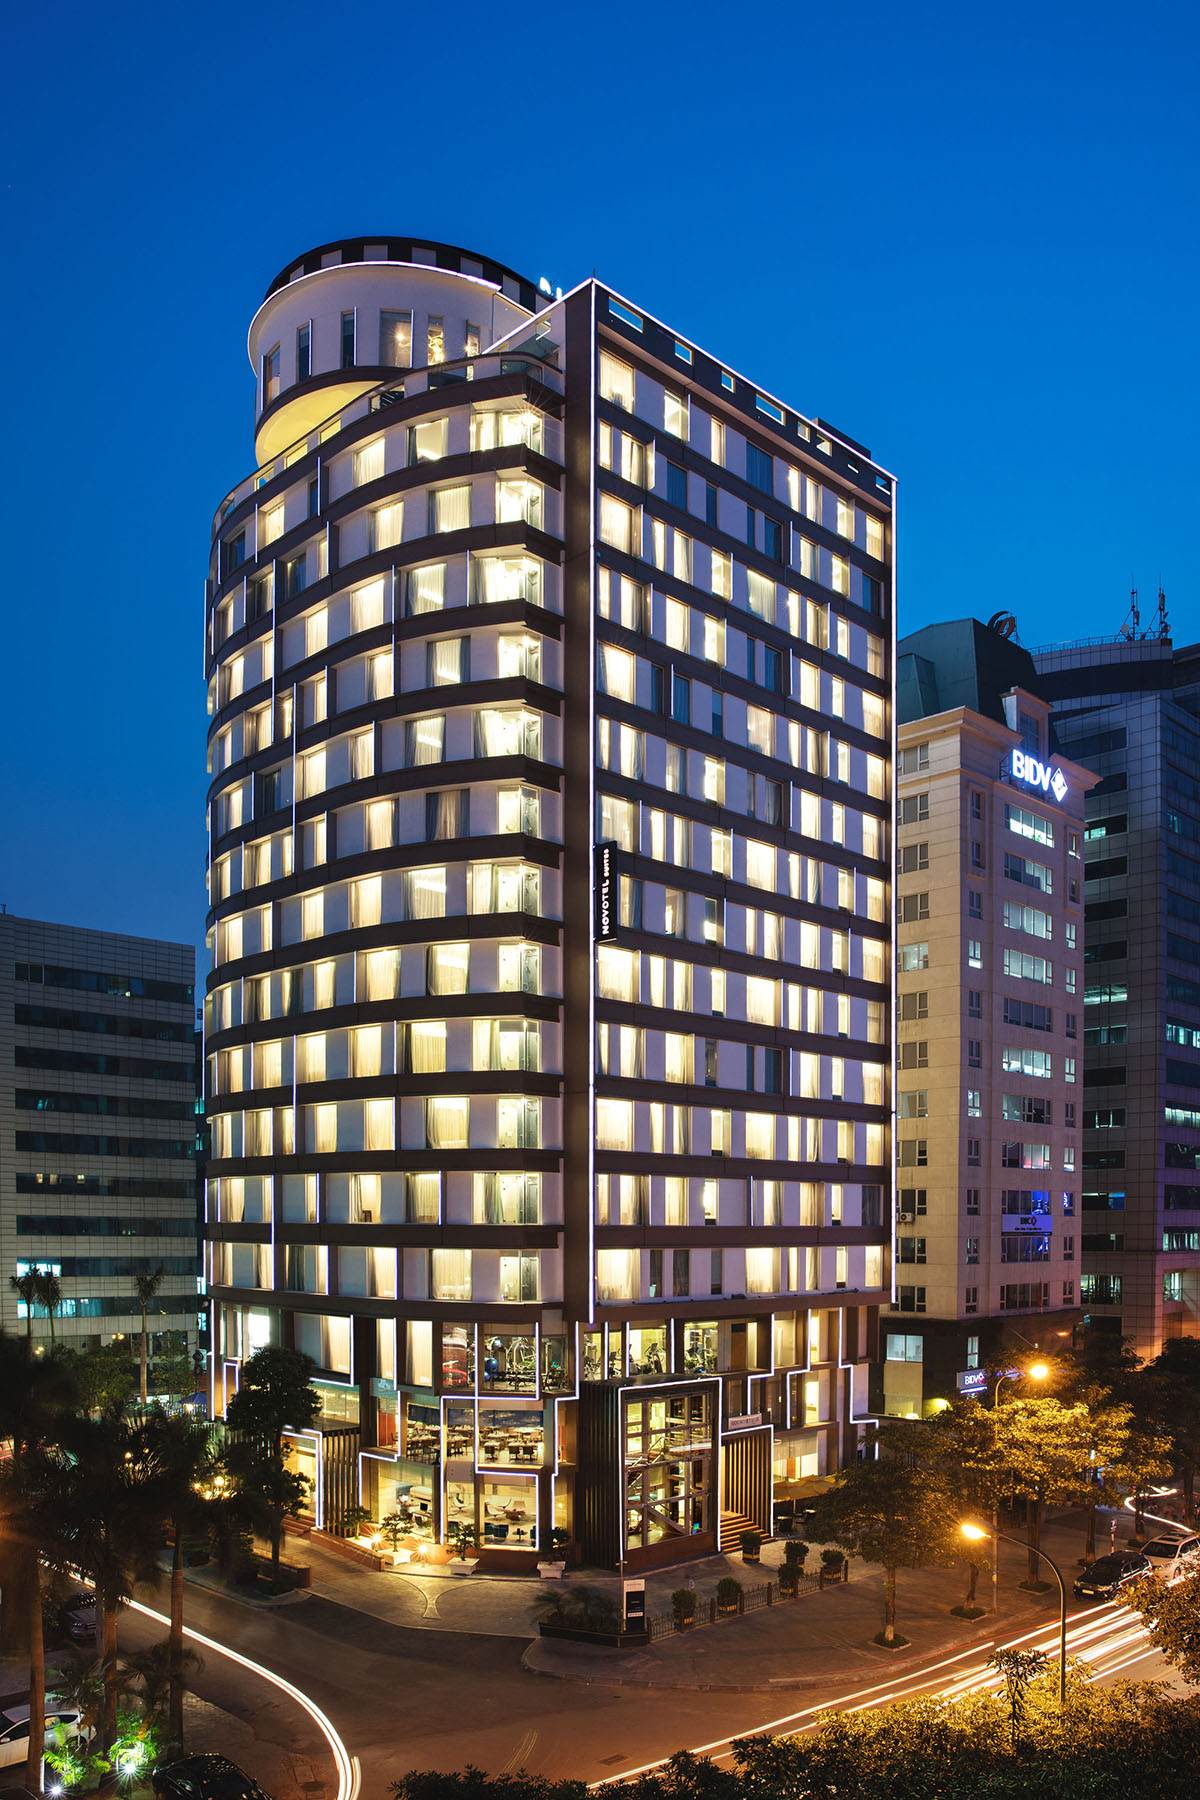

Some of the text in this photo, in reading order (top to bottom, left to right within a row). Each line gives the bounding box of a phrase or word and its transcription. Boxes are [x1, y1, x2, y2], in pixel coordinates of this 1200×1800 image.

[1012, 749, 1051, 791] BIDV
[602, 879, 610, 935] NOVOTEL
[964, 1374, 979, 1385] BIDV
